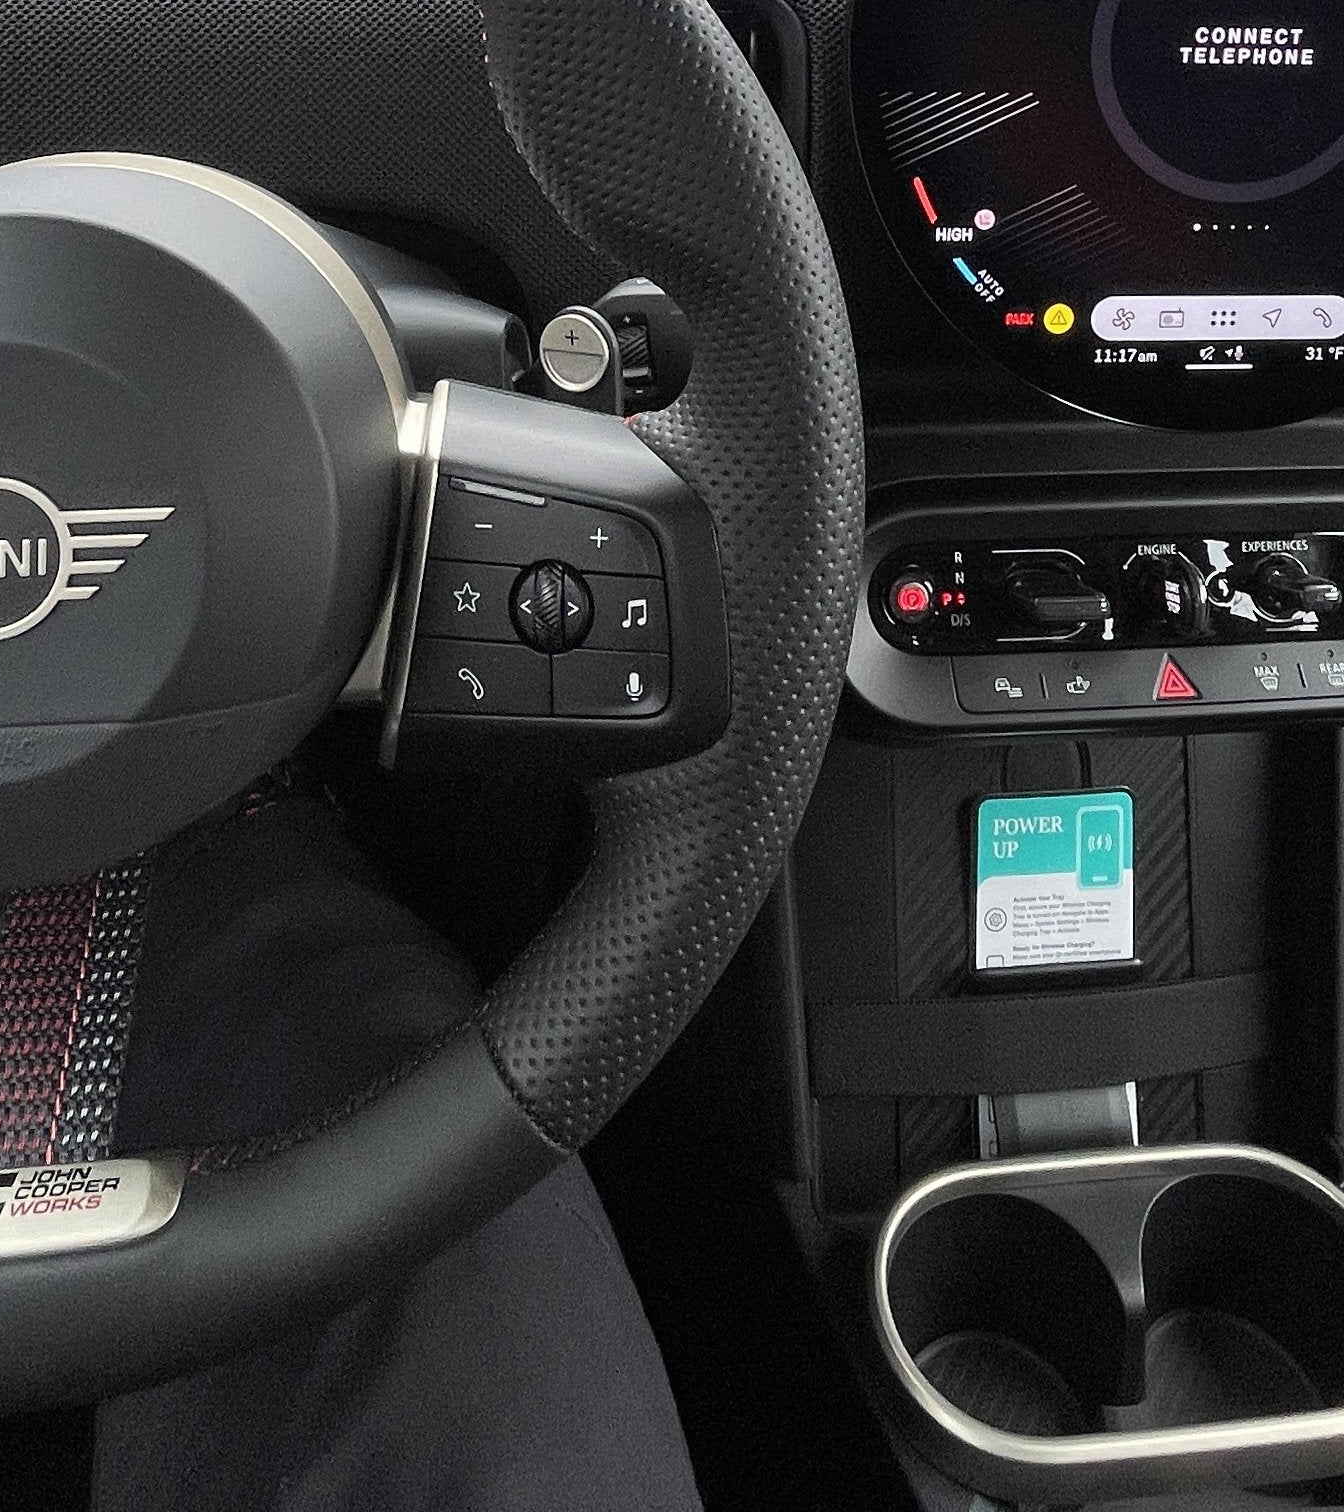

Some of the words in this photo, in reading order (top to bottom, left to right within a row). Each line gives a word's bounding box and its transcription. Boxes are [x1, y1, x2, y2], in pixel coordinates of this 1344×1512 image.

[1194, 26, 1304, 46] CONNECT
[1179, 47, 1315, 66] TELEPHONE
[935, 227, 974, 242] HIGH
[977, 269, 1005, 297] AUTO
[974, 282, 996, 303] OFF
[1005, 312, 1036, 326] PARK
[1093, 348, 1158, 364] 11:17am
[1304, 346, 1324, 362] 31
[1137, 543, 1178, 556] ENGINE
[1241, 539, 1309, 553] EXPERIENCES
[954, 551, 963, 564] R
[954, 571, 965, 585] N
[941, 592, 952, 606] P
[950, 613, 971, 627] D/S
[1253, 665, 1280, 678] MAX
[992, 815, 1065, 836] POWER
[992, 840, 1020, 860] UP
[19, 1166, 94, 1186] JOHN
[13, 1177, 121, 1201] COOPER
[8, 1194, 104, 1218] WORKS
